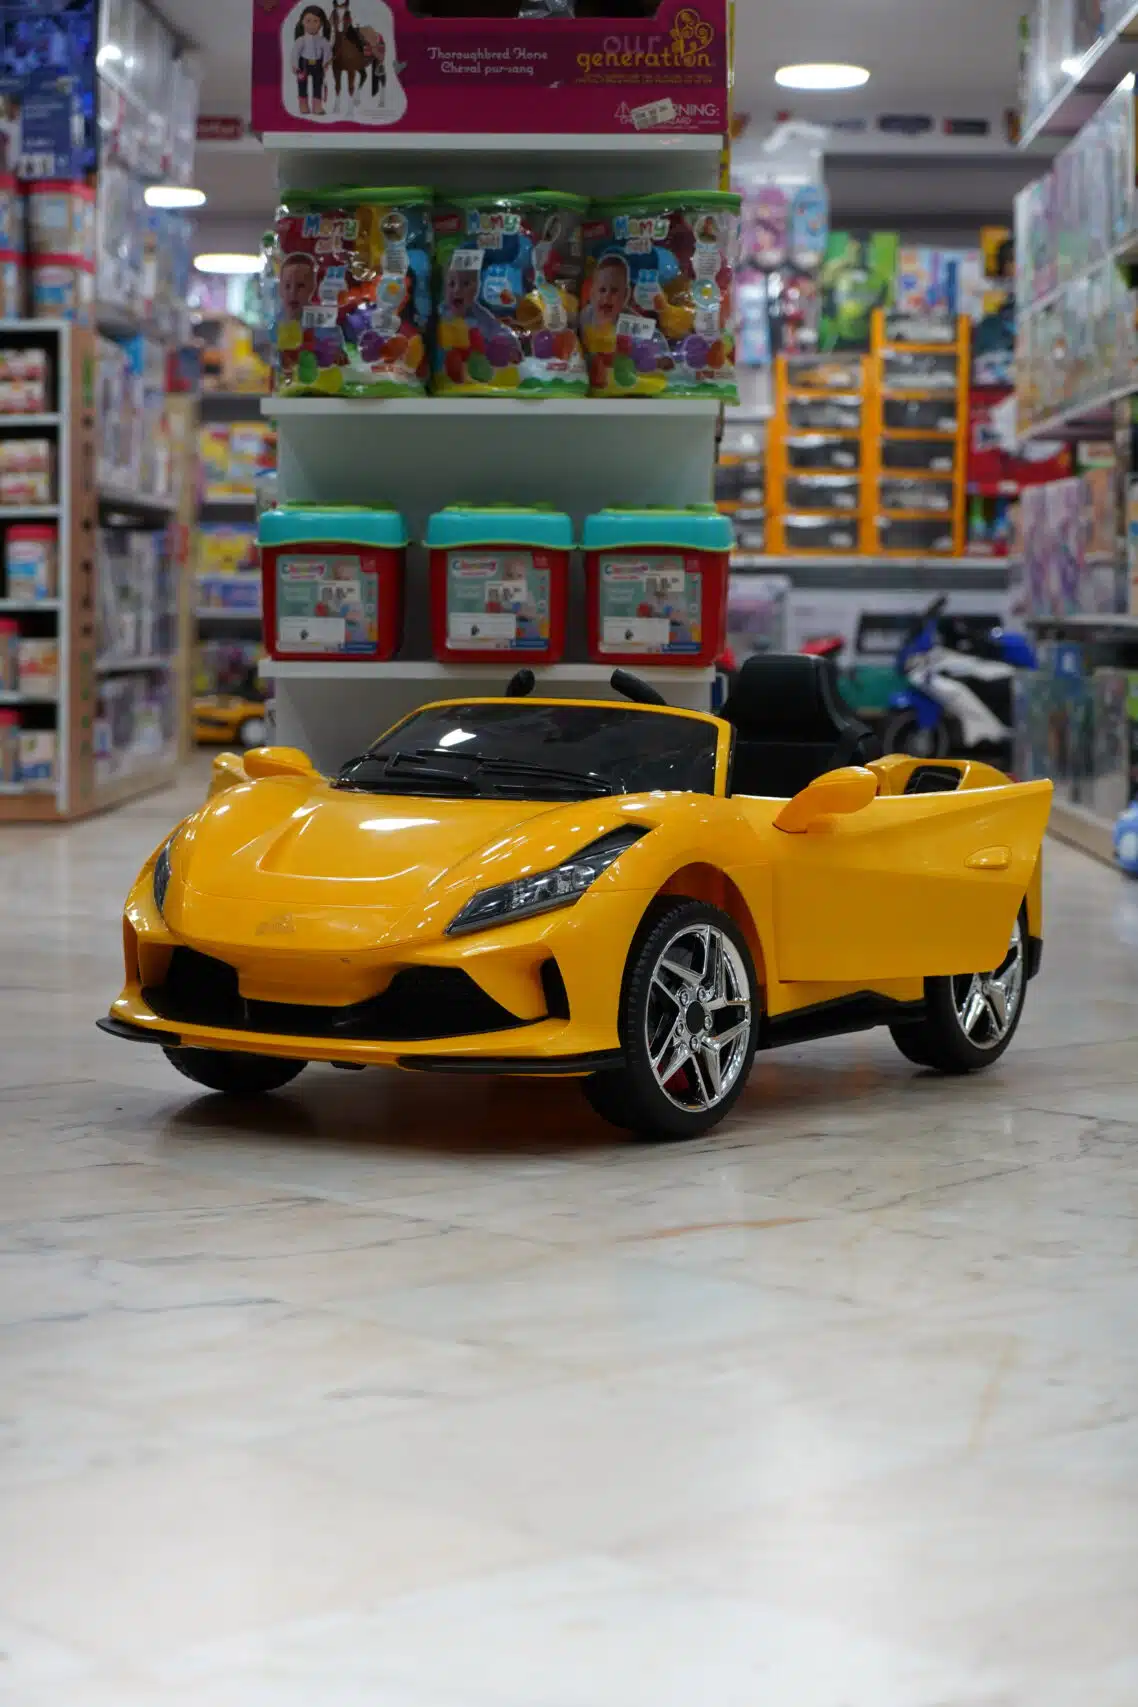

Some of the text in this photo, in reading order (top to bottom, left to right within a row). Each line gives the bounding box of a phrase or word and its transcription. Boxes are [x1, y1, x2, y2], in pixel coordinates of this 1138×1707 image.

[603, 35, 662, 54] our
[441, 61, 481, 74] Cheval
[576, 46, 712, 73] generation
